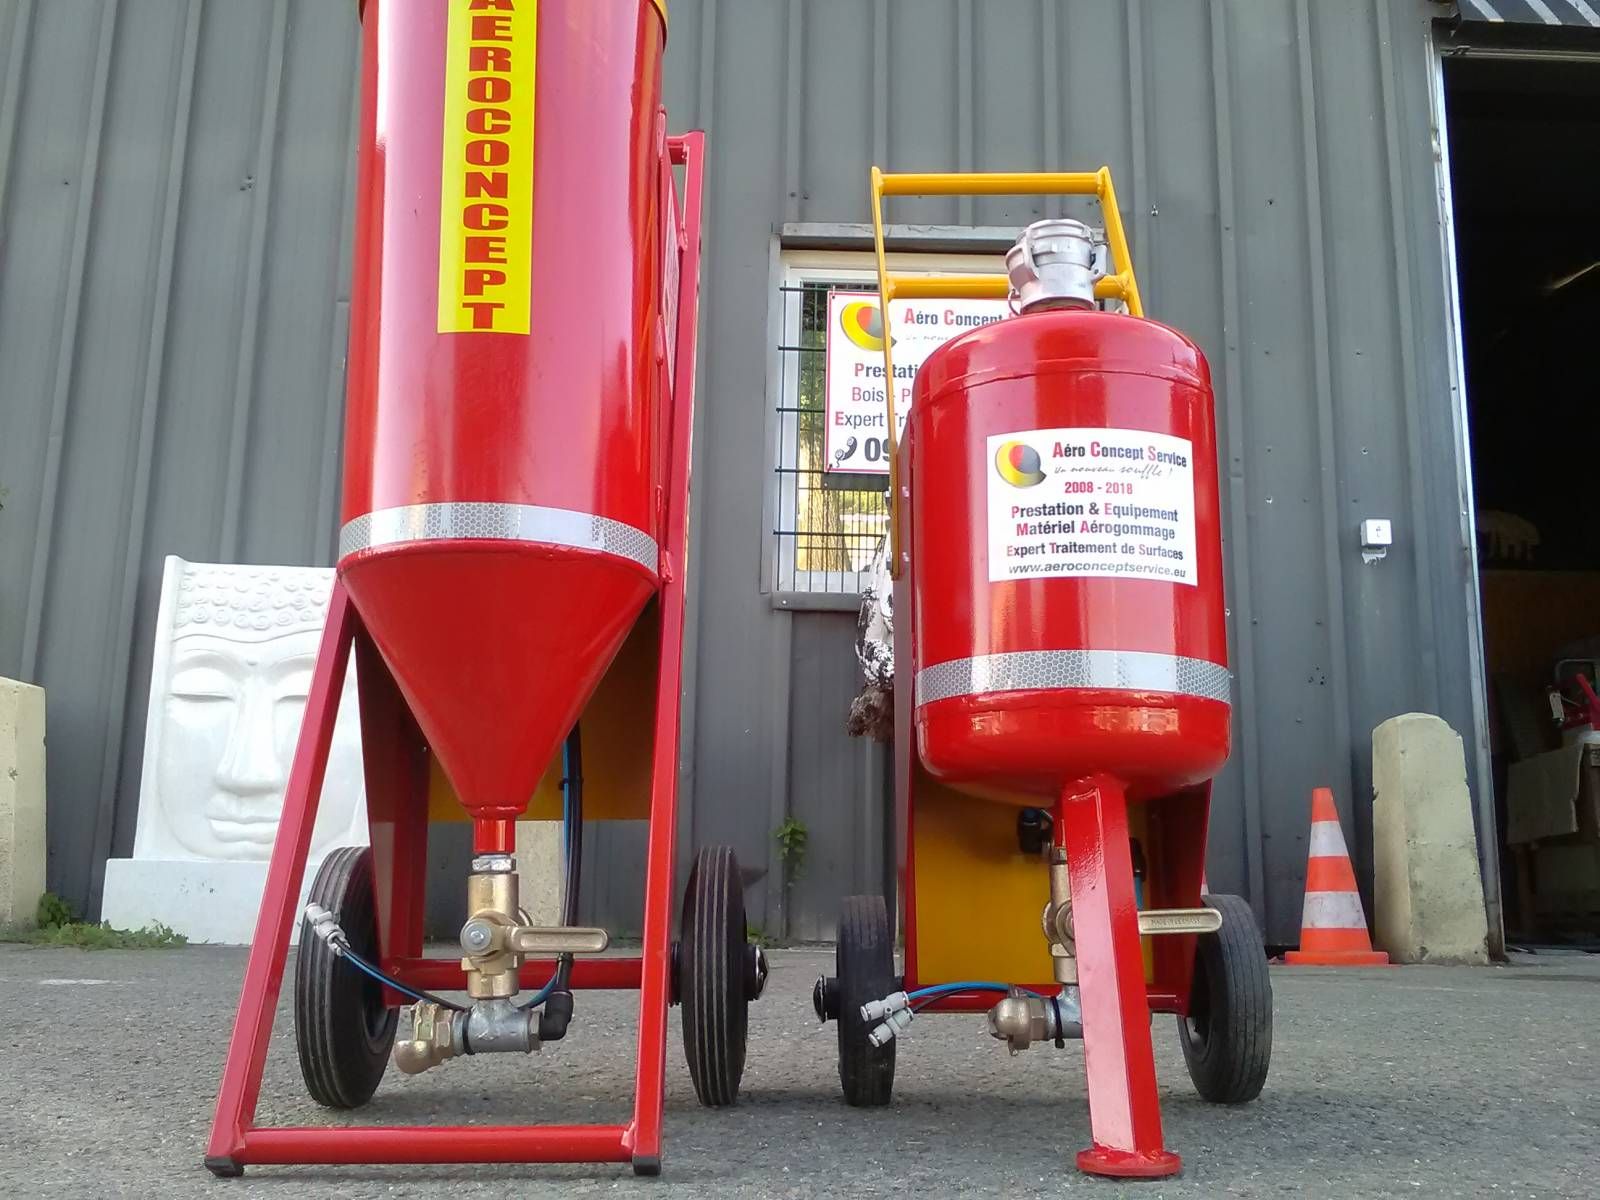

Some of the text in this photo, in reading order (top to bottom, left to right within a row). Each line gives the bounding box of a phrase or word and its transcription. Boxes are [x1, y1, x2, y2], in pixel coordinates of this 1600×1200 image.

[904, 308, 938, 325] Aéro
[852, 387, 884, 402] Bois
[835, 411, 884, 429] Expert
[1052, 441, 1187, 468] Aéro Concept Service
[1119, 464, 1163, 480] souffle
[1064, 481, 1094, 493] 2008
[1105, 481, 1133, 495] 2018
[1011, 501, 1179, 522] Prestation & Equipement
[1016, 520, 1175, 541] Matériel Aérogommage
[1006, 541, 1184, 560] Expert Traitement de Surfaces
[1008, 562, 1186, 578] www.aeroconceptservice.eu
